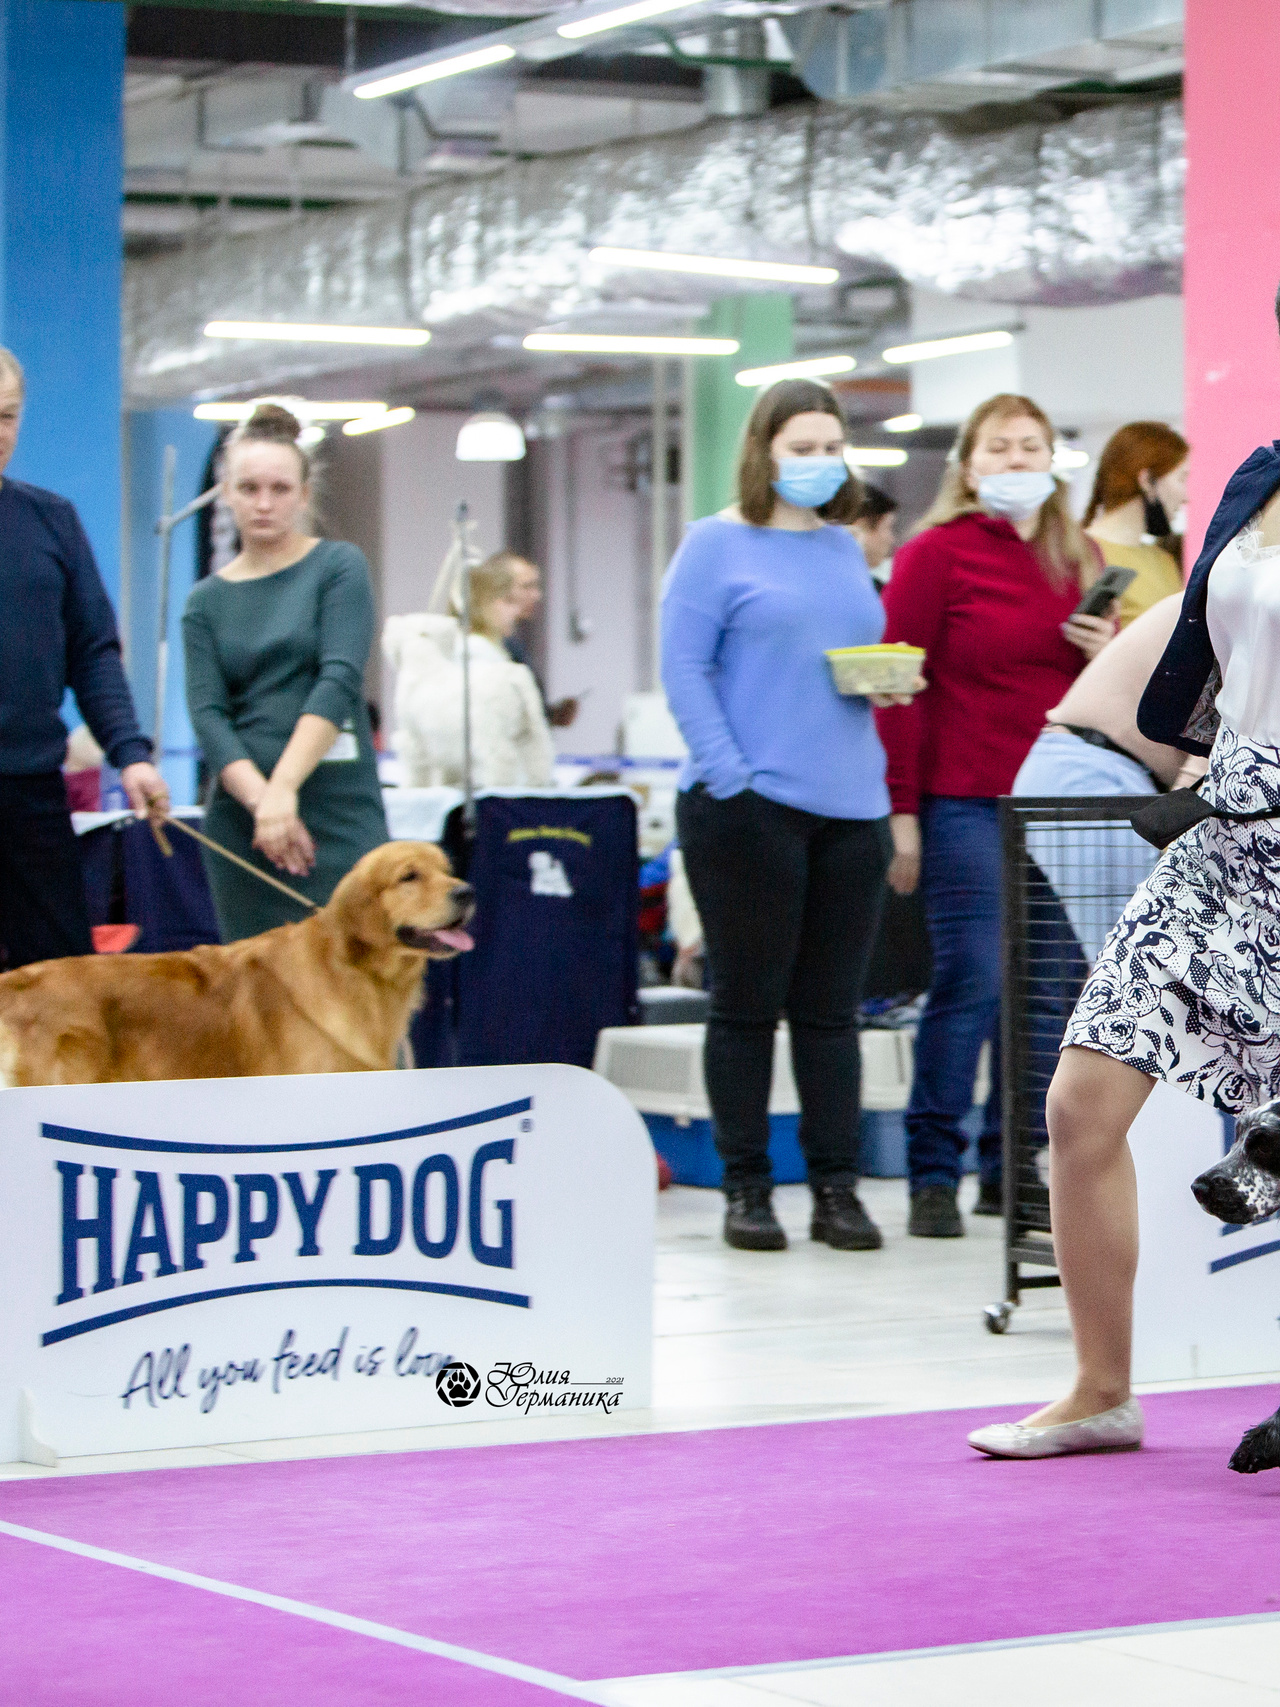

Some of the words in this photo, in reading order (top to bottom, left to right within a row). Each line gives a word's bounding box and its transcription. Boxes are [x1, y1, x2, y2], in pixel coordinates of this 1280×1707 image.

[56, 1160, 338, 1305] HAPPY
[353, 1137, 515, 1269] DOG
[120, 1343, 190, 1409] All
[198, 1357, 263, 1413] you
[272, 1327, 349, 1393] feed
[354, 1346, 385, 1377] is
